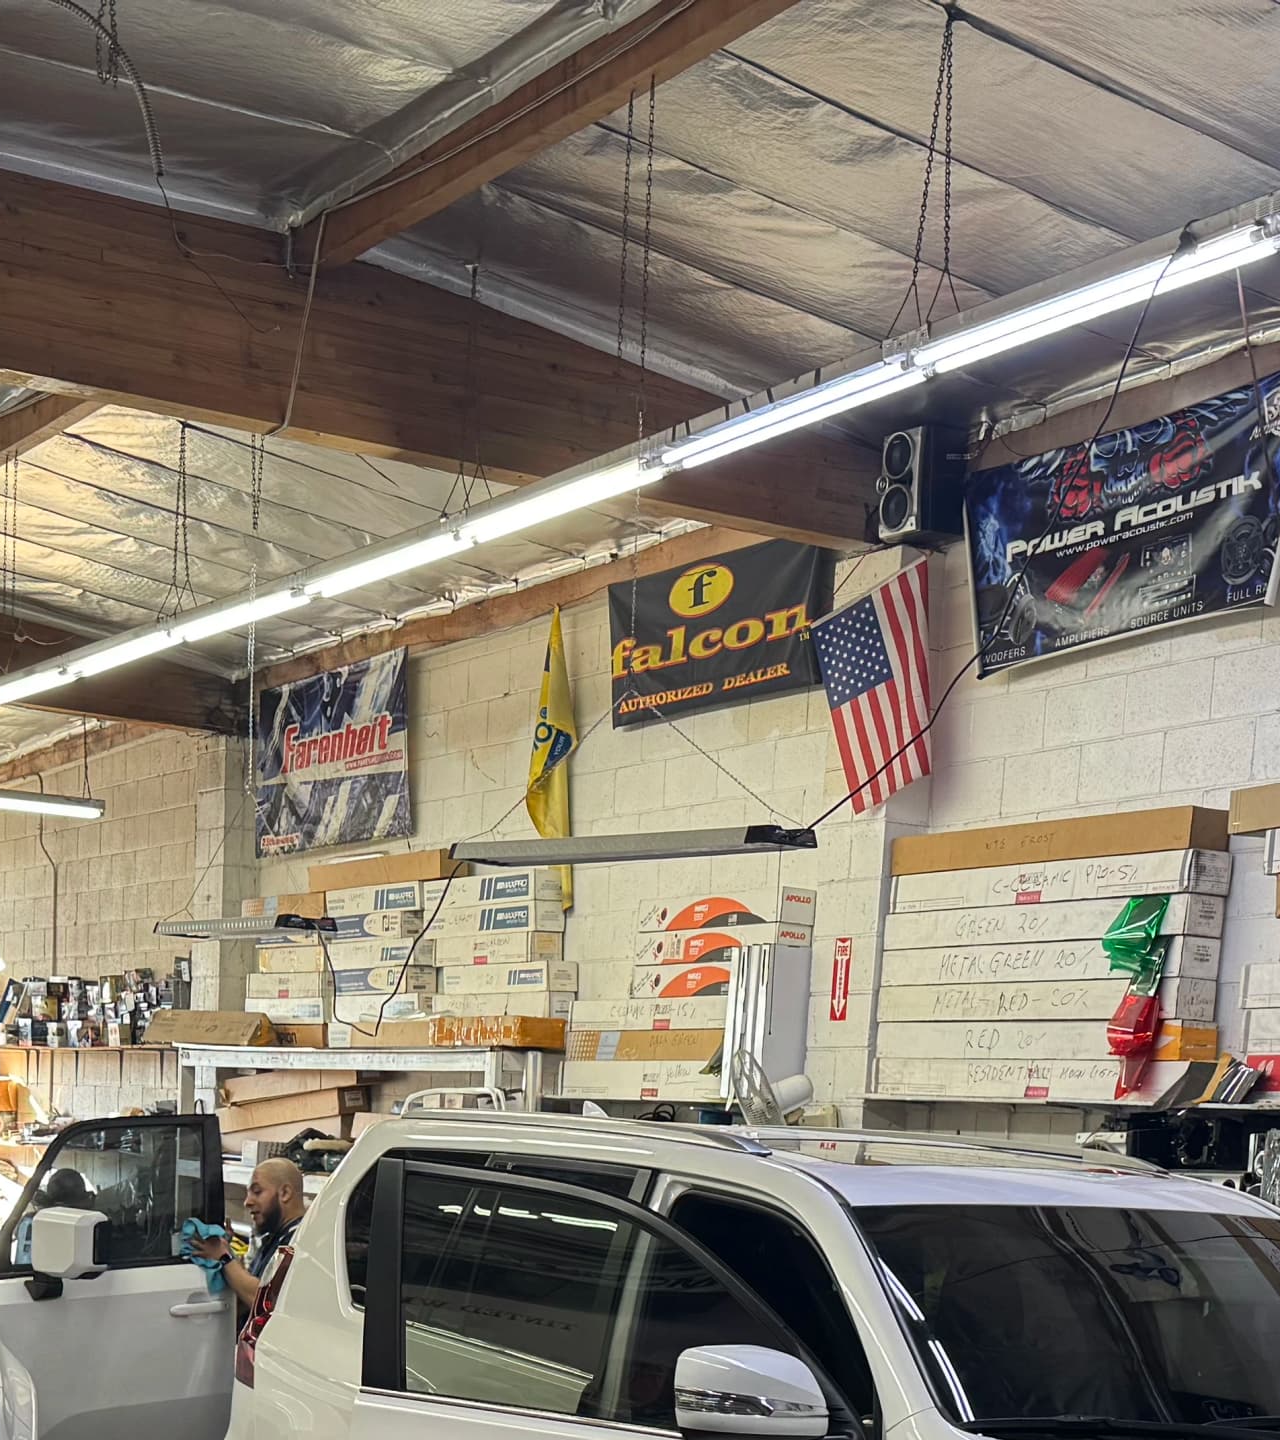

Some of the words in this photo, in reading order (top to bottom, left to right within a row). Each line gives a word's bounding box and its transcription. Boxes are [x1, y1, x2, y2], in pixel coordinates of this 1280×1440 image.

[1006, 520, 1106, 564] POWER
[1114, 471, 1264, 533] ACOUSTIK
[611, 603, 816, 679] falcon
[1055, 625, 1110, 648] AMPLIFIERS
[1130, 608, 1170, 630] SOURCE
[1173, 601, 1205, 622] UNITS
[1227, 588, 1250, 604] FULL
[619, 682, 714, 714] AUTHORIZED
[723, 662, 791, 692] DEALER
[280, 712, 393, 774] Farenheit
[785, 893, 812, 905] APOLLO
[779, 929, 806, 941] APOLLO
